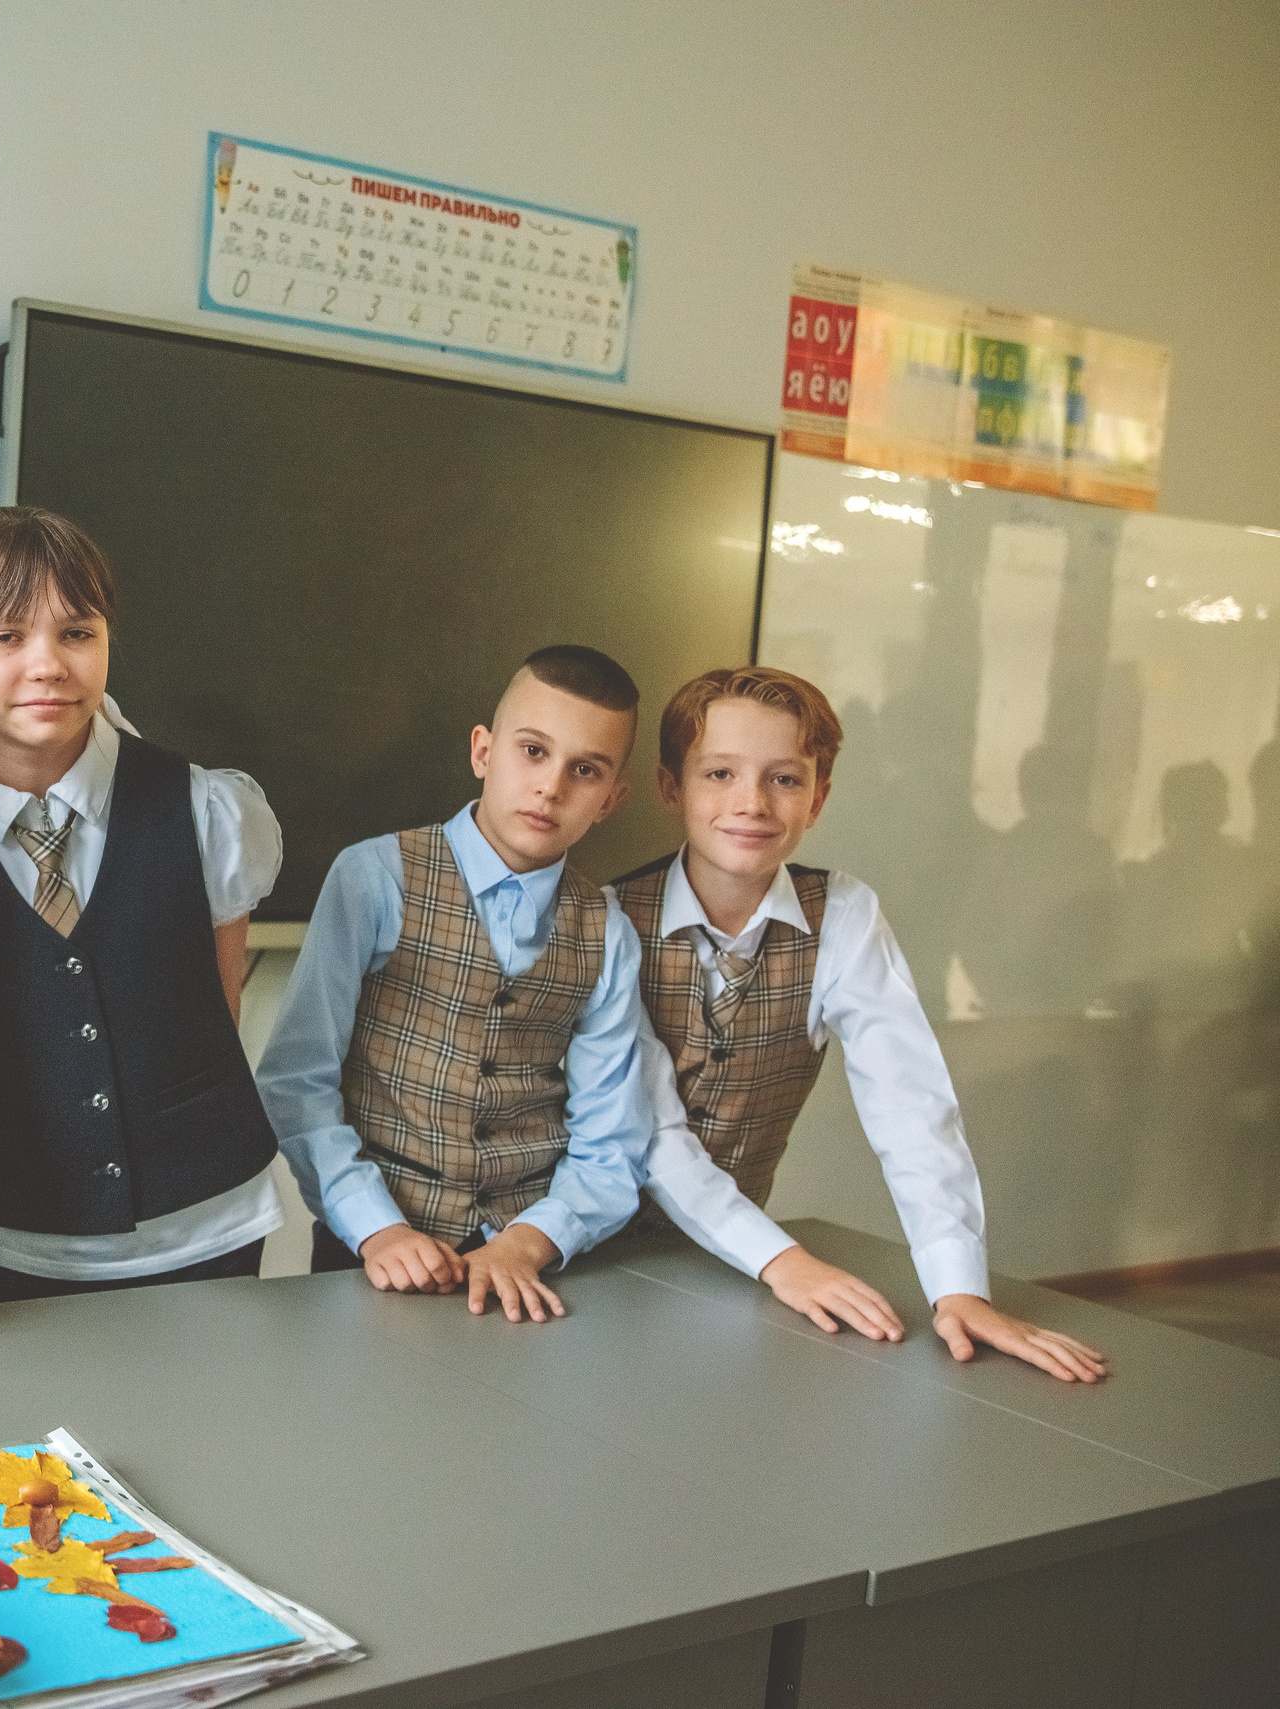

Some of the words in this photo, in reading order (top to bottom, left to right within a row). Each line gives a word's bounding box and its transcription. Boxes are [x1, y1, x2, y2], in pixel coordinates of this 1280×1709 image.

[351, 176, 417, 207] ПИШЕМ
[419, 192, 520, 229] ПРАВИЛЬНО
[233, 268, 251, 298] 0
[282, 278, 295, 306] 1
[321, 285, 339, 315] 2
[365, 293, 382, 322] 3
[408, 302, 421, 329] 4
[442, 309, 461, 336] 5
[486, 316, 501, 344] 6
[524, 323, 539, 350] 7
[562, 330, 577, 358] 8
[791, 310, 807, 339] а
[813, 315, 829, 344] о
[836, 318, 854, 356] у
[787, 370, 804, 398] я
[809, 363, 825, 403] ё
[828, 377, 849, 406] ю
